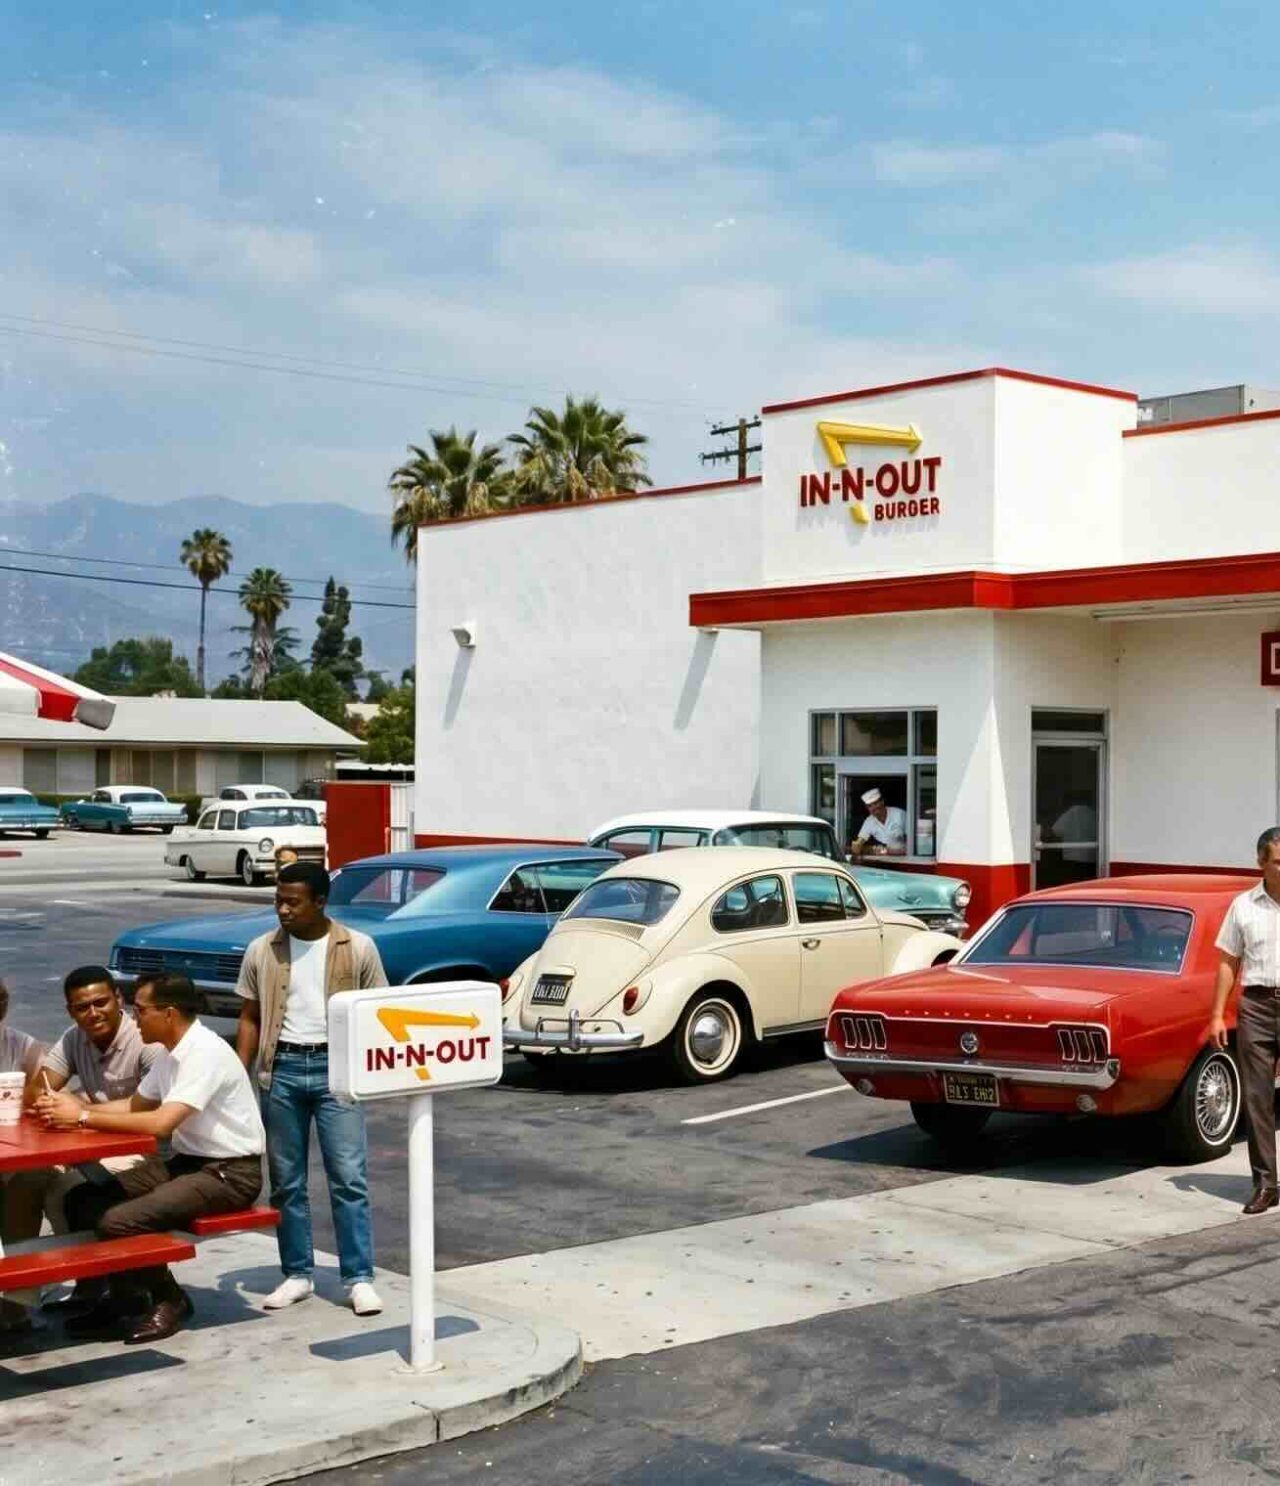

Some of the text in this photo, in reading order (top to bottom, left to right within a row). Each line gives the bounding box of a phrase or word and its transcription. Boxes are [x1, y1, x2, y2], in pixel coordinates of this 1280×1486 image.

[800, 456, 942, 507] IN-N-OUT
[874, 497, 940, 521] BURGER
[366, 1036, 491, 1072] IN-N-OUT
